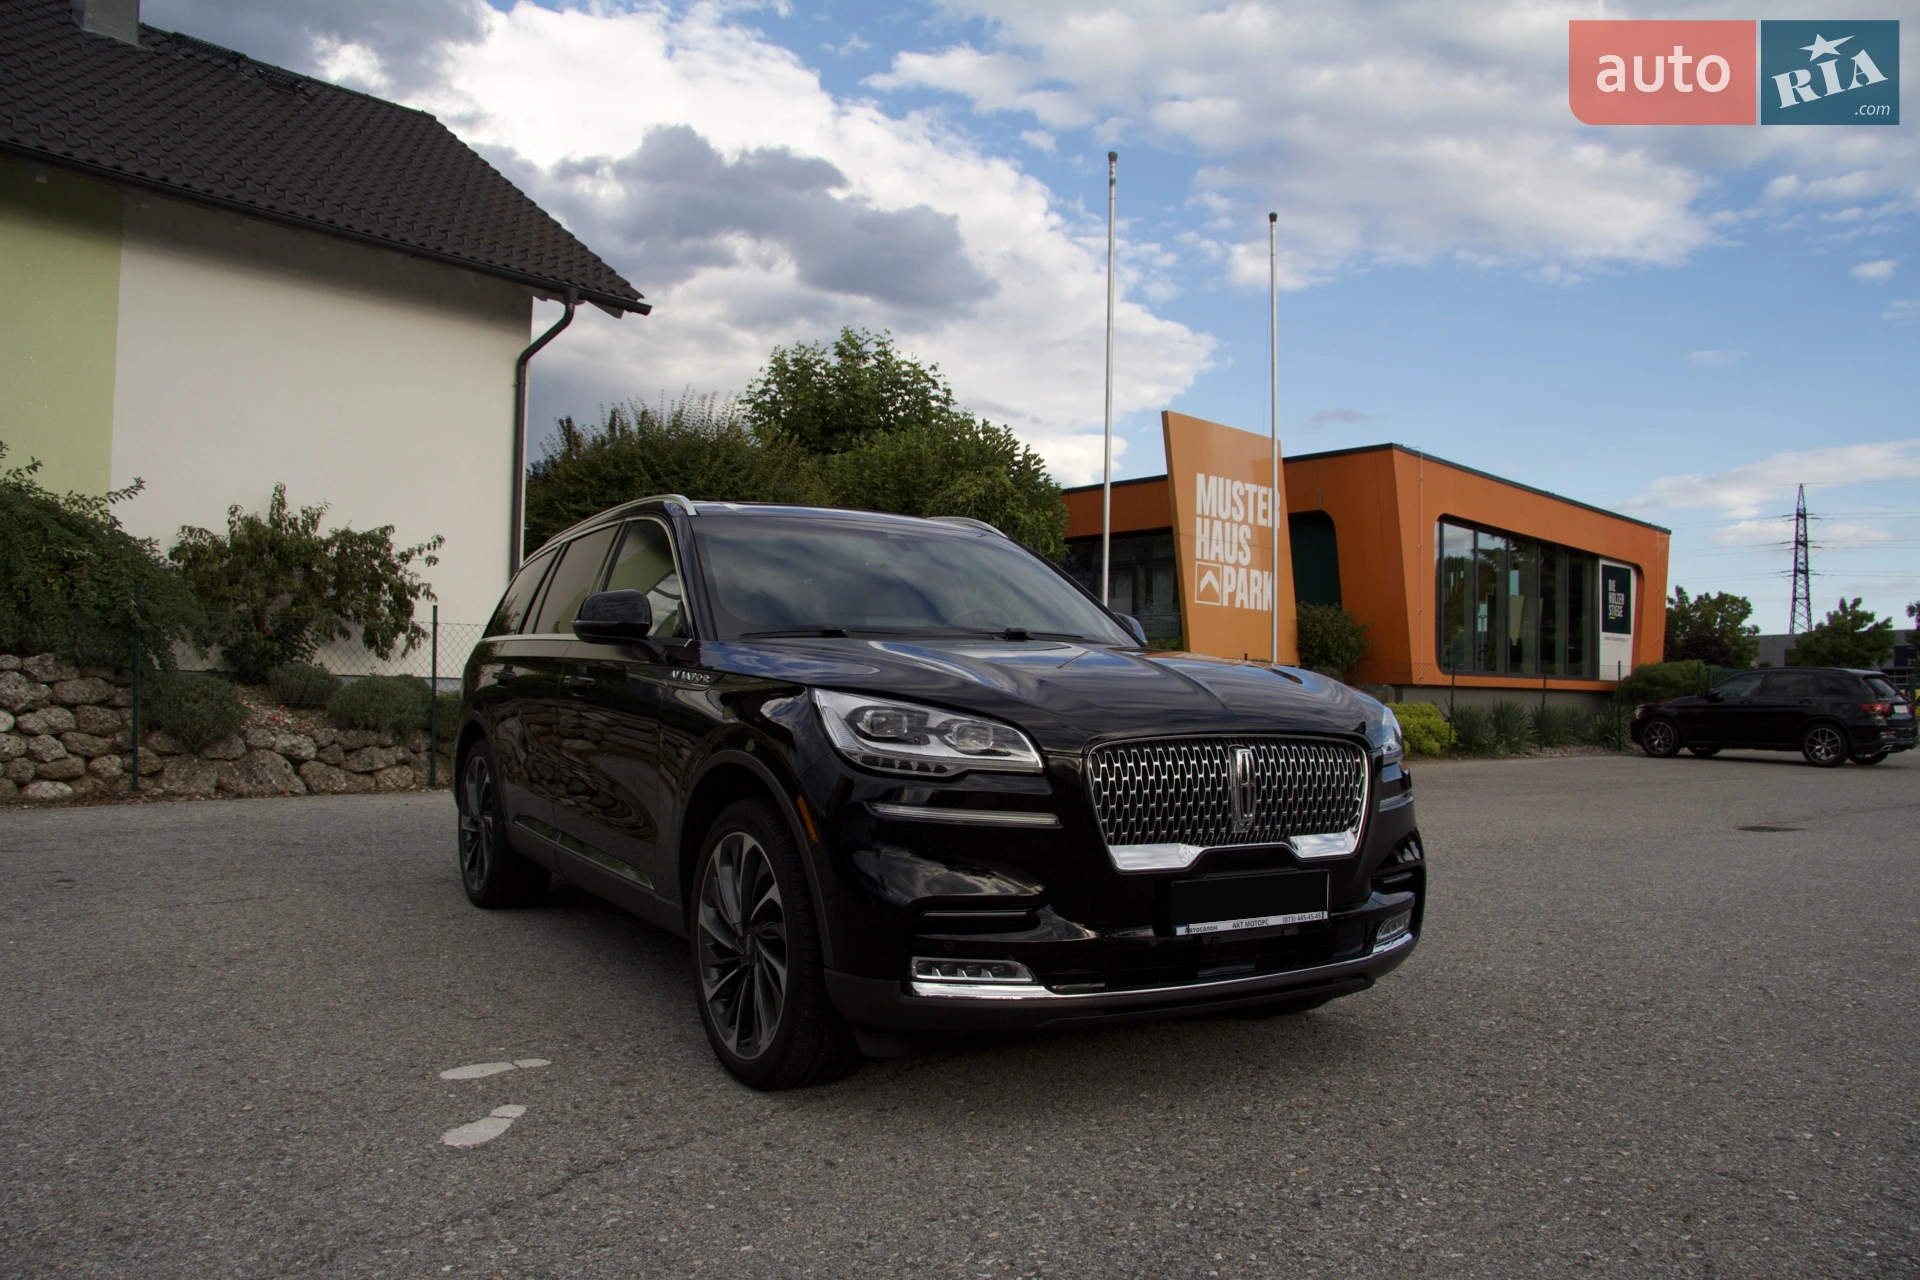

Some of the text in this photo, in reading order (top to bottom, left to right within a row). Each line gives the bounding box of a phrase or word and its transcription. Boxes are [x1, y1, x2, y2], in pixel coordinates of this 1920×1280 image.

[1196, 472, 1280, 529] MUSTER
[1196, 516, 1251, 566] HAUS
[1222, 565, 1274, 611] PARK
[1232, 921, 1244, 929] АКТ
[1244, 919, 1269, 928] МОТОРС
